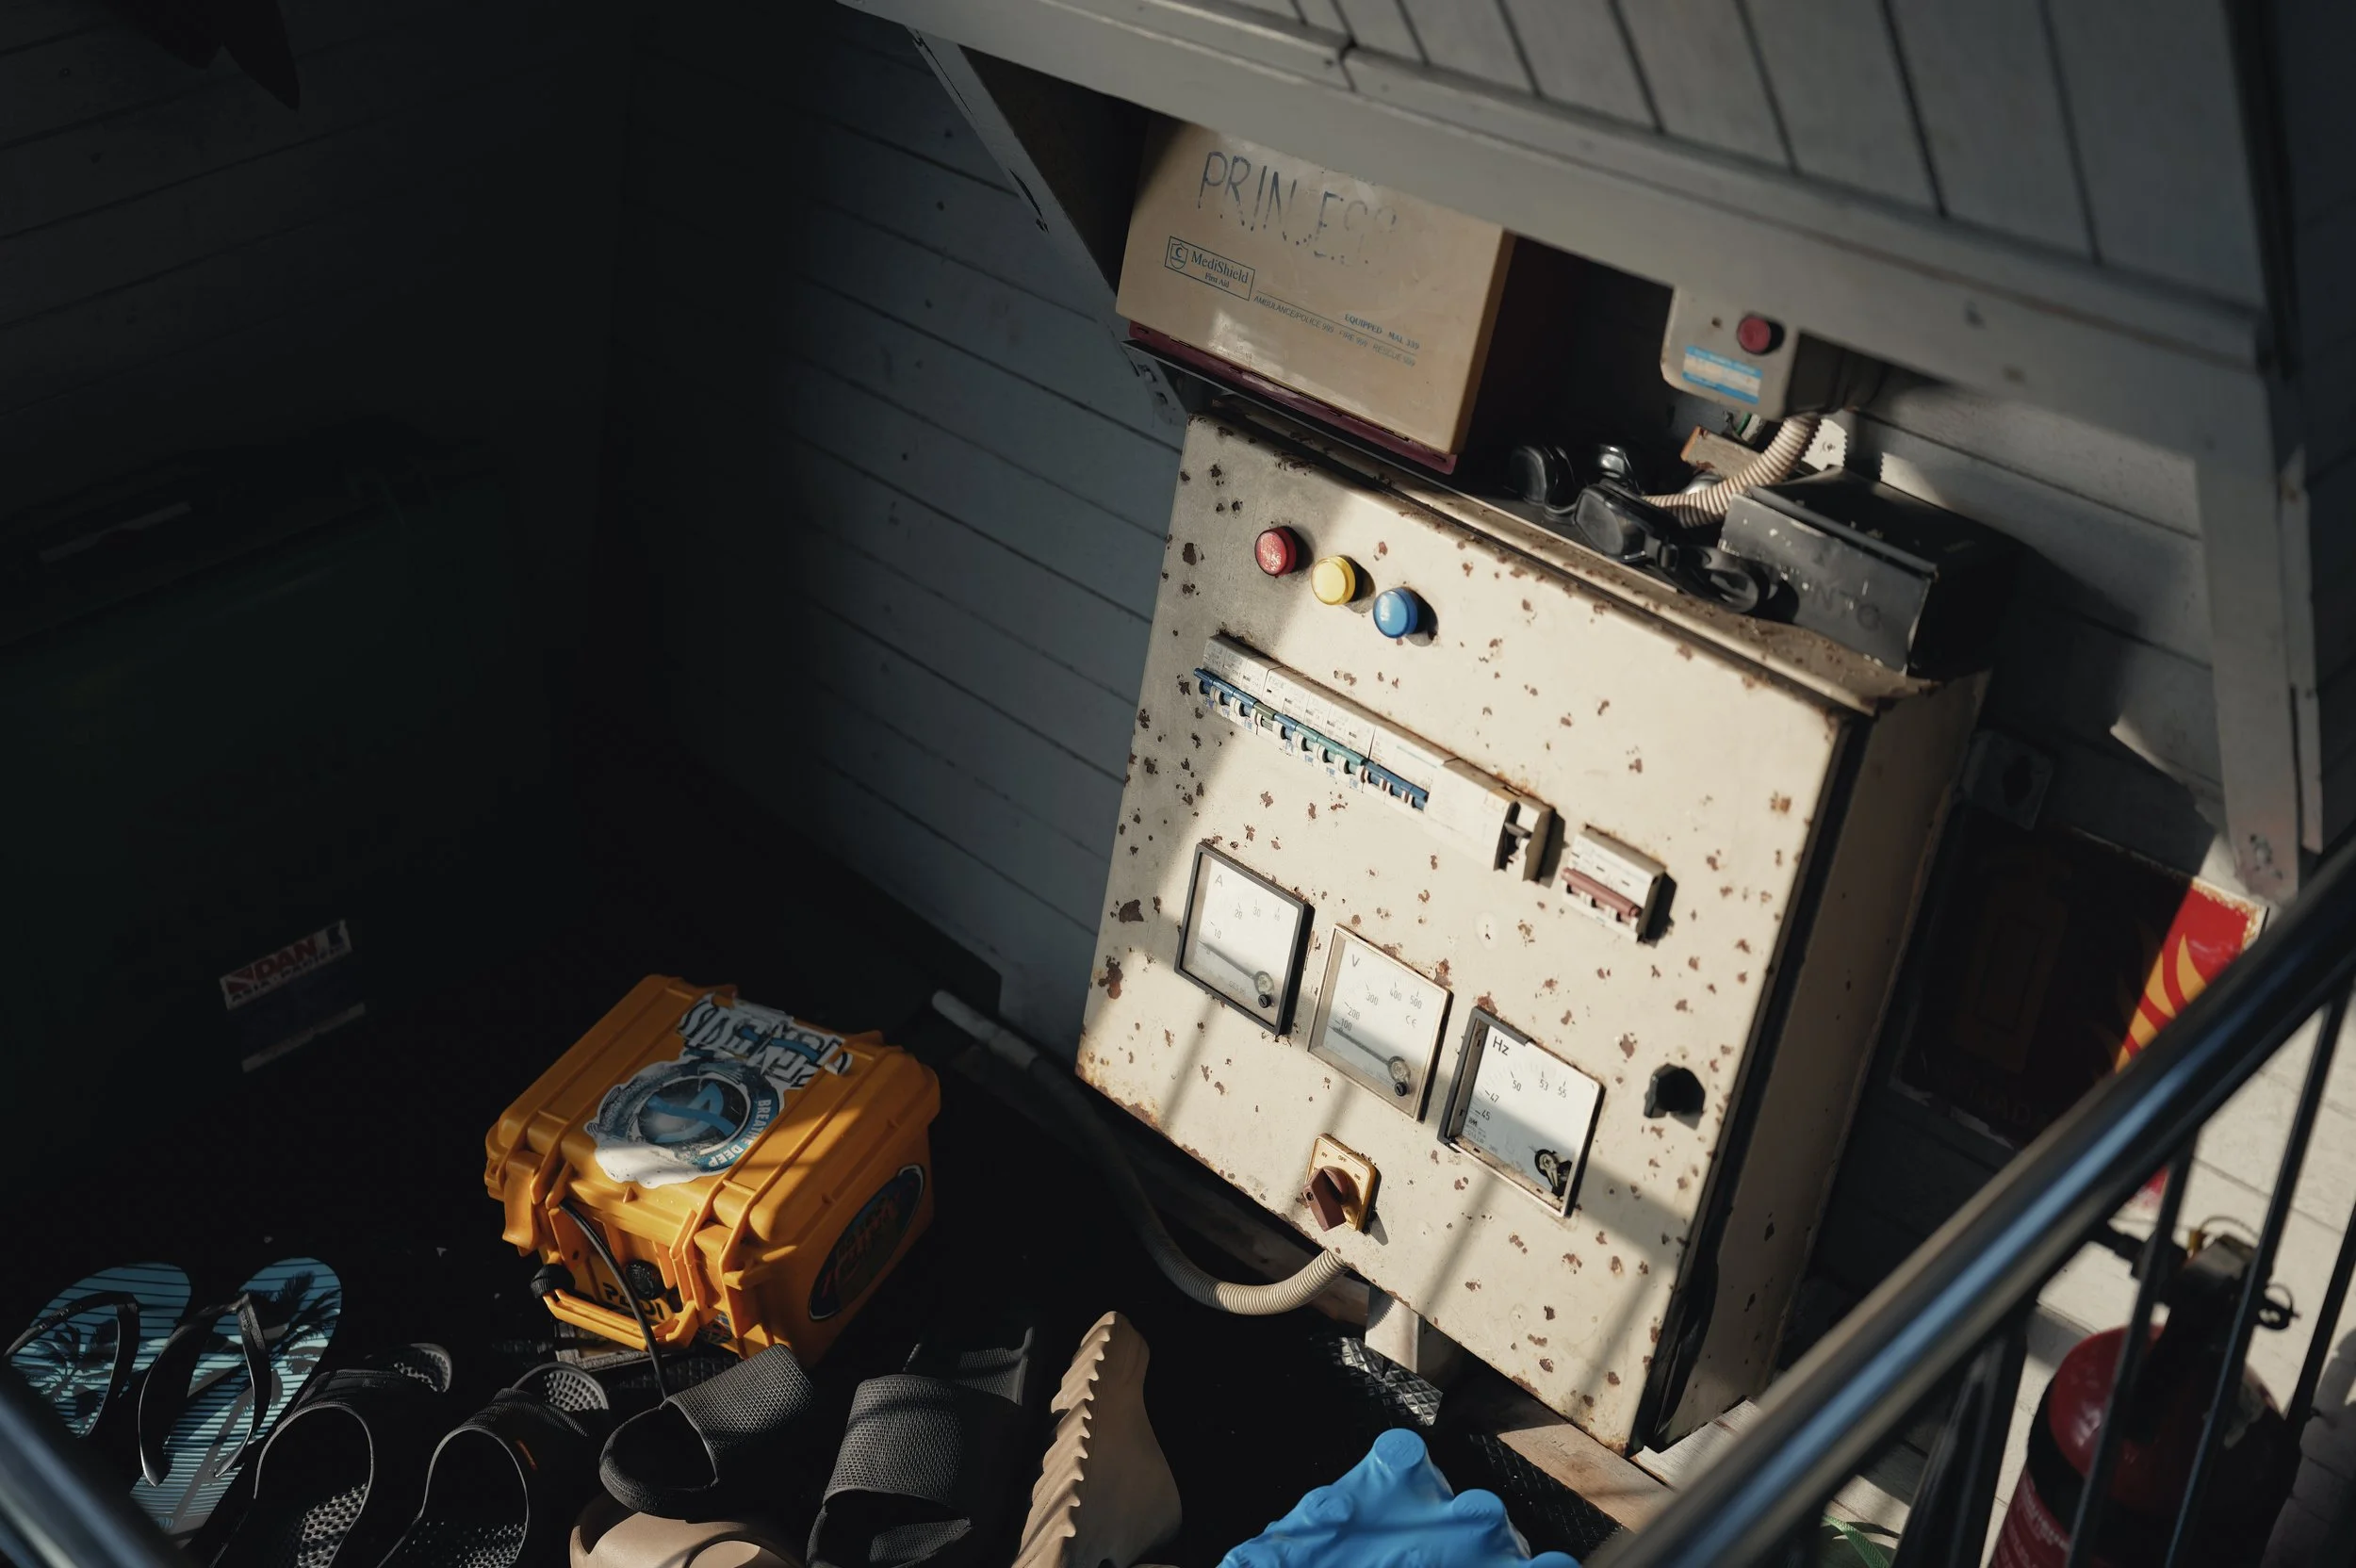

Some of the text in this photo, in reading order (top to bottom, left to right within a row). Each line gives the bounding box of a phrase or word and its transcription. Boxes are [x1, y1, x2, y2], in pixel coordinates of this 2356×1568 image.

[1198, 151, 1399, 267] PRINES
[1191, 251, 1249, 283] MediShield
[1345, 313, 1383, 335] EQUIPPED
[1252, 906, 1261, 918] 30
[254, 937, 317, 981] DAN
[1351, 954, 1361, 968] V
[1366, 991, 1379, 1006] 300
[1389, 988, 1402, 1002] 400
[1410, 995, 1423, 1009] 500
[1348, 1006, 1361, 1020] 200
[1340, 1018, 1352, 1032] 100
[1492, 1036, 1510, 1056] Hz
[1512, 1080, 1522, 1092] 50
[1539, 1079, 1549, 1091] 53
[1490, 1093, 1500, 1103] 47
[1557, 1086, 1567, 1099] 55
[1481, 1109, 1491, 1121] 45
[708, 1144, 744, 1168] DEEP
